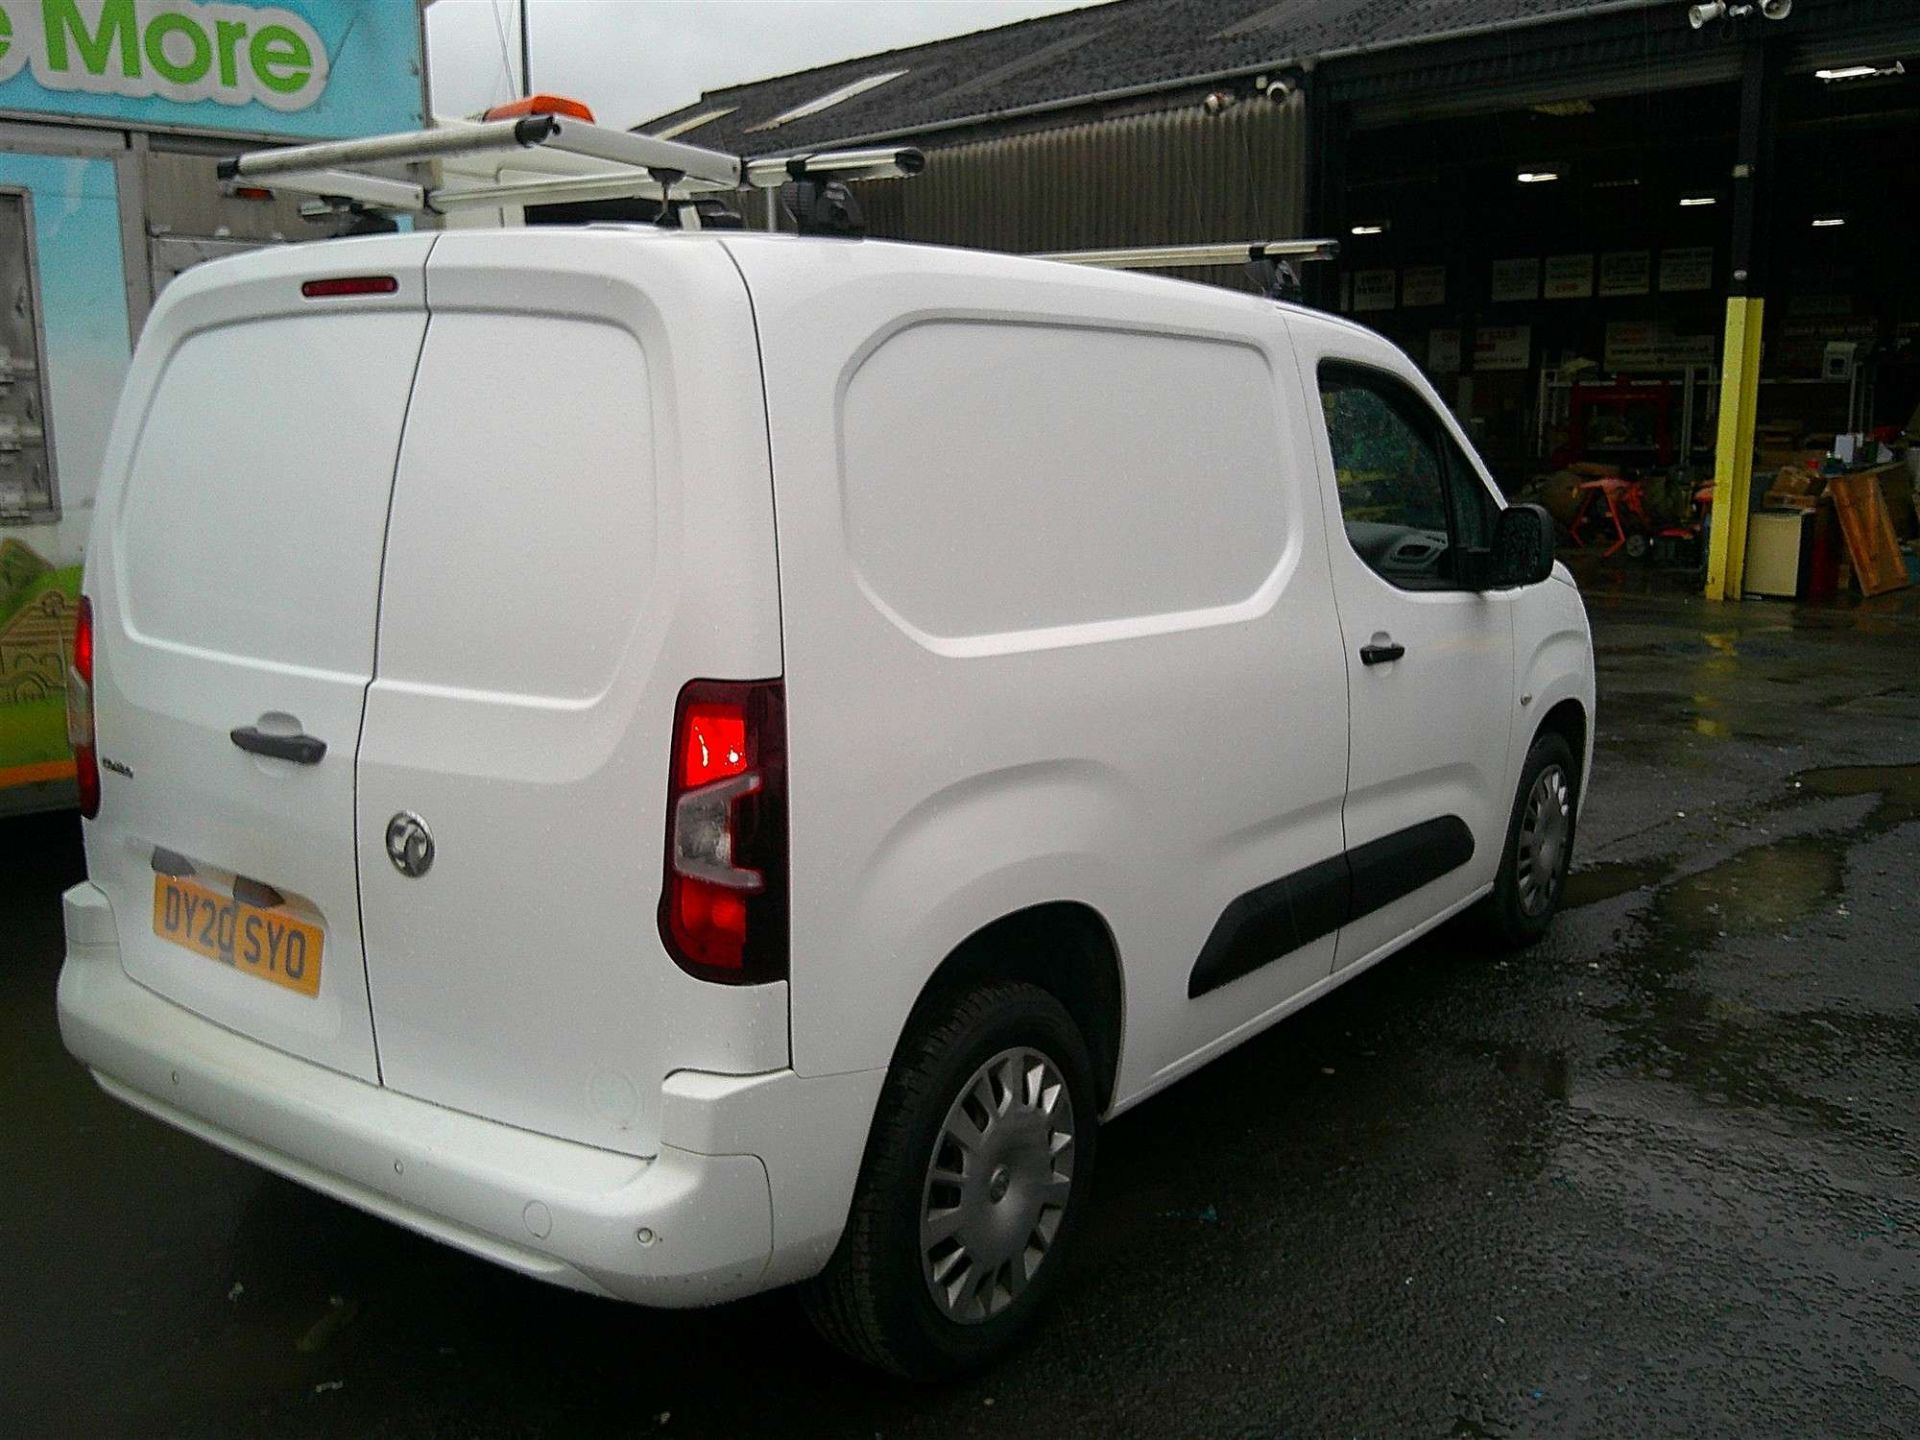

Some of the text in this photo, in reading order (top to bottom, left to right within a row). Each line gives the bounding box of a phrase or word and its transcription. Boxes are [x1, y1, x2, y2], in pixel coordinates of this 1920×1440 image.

[42, 0, 312, 93] More
[164, 885, 306, 980] DY20 SYO
